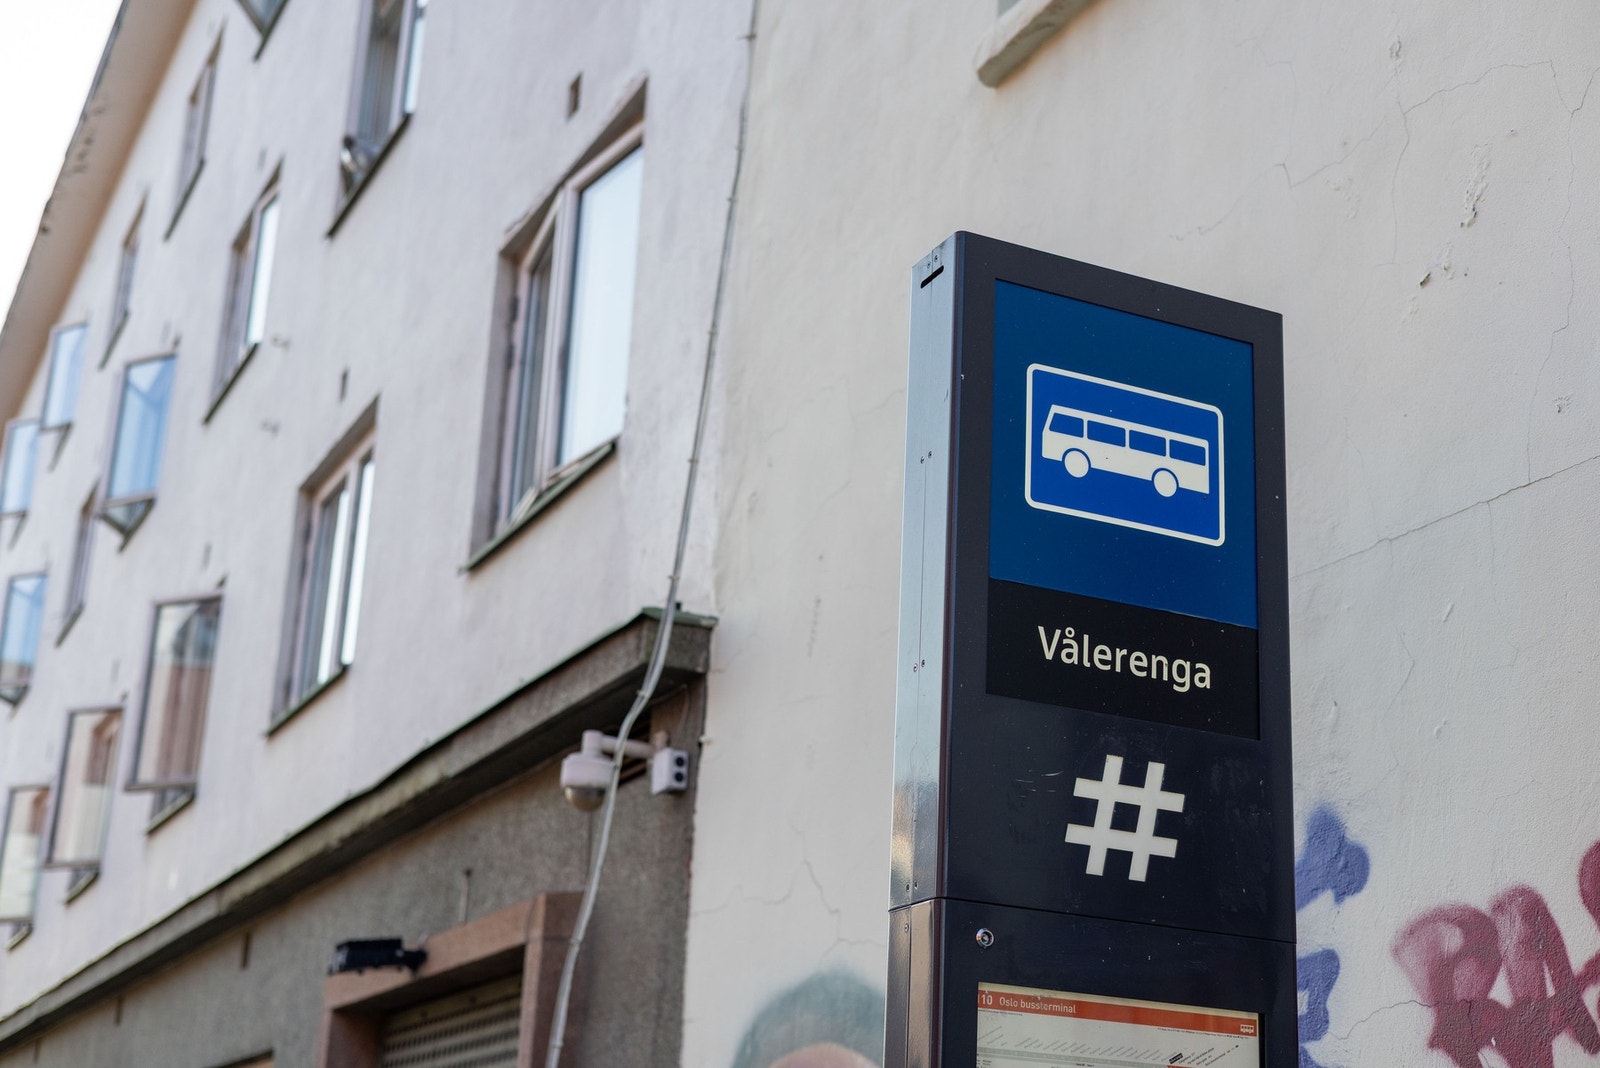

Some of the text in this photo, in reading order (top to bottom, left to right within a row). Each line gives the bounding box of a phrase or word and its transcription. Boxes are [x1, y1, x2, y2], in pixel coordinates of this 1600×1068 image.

[1037, 625, 1212, 693] Vålerenga
[981, 994, 993, 1006] 10
[999, 997, 1018, 1008] Oslo
